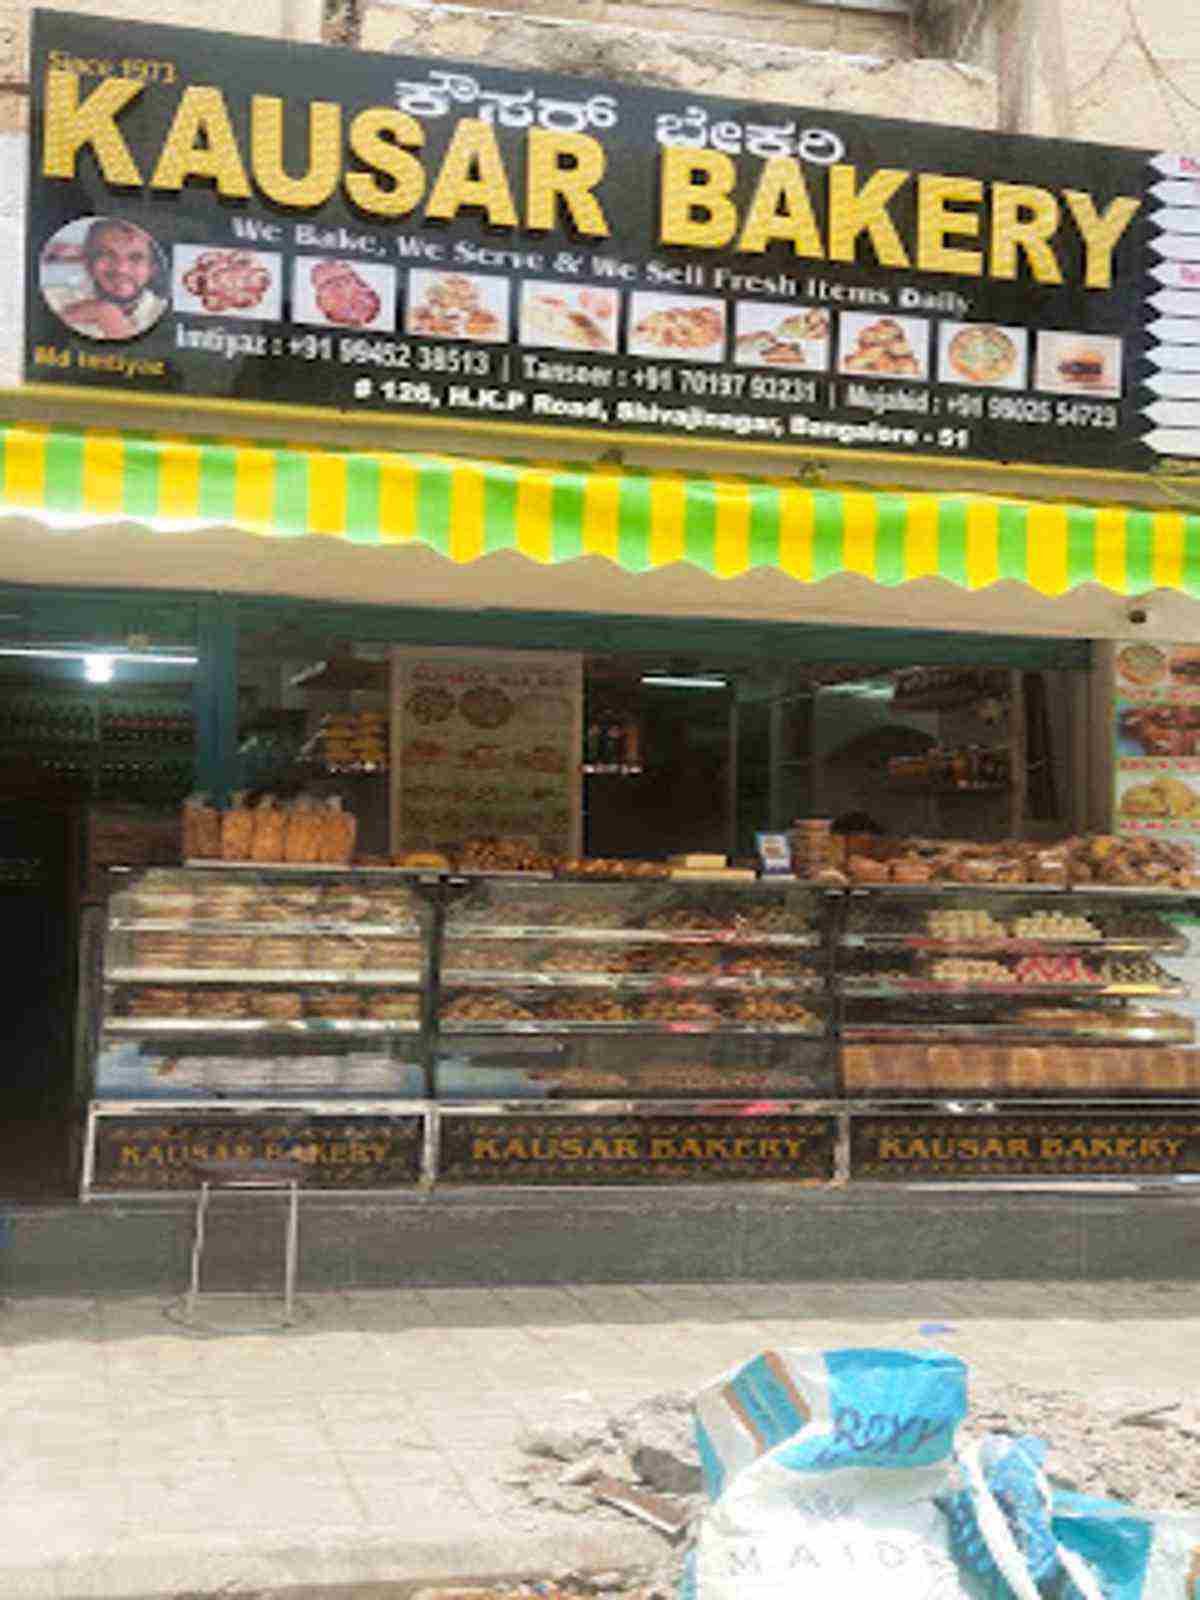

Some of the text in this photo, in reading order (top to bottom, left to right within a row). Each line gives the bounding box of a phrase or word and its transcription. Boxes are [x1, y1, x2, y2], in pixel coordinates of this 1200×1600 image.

[42, 70, 1141, 289] KAUSAR BAKERY
[231, 216, 282, 243] We
[295, 223, 387, 257] Bake,
[397, 235, 447, 261] We
[453, 240, 546, 271] Serve
[554, 251, 582, 274] &
[646, 258, 703, 287] Sell
[714, 267, 797, 297] Fresh
[807, 278, 890, 306] Items
[901, 286, 972, 317] Daily
[472, 1135, 808, 1162] KAUSAR BAKERY
[878, 1137, 1186, 1160] KAUSAR BAKERY
